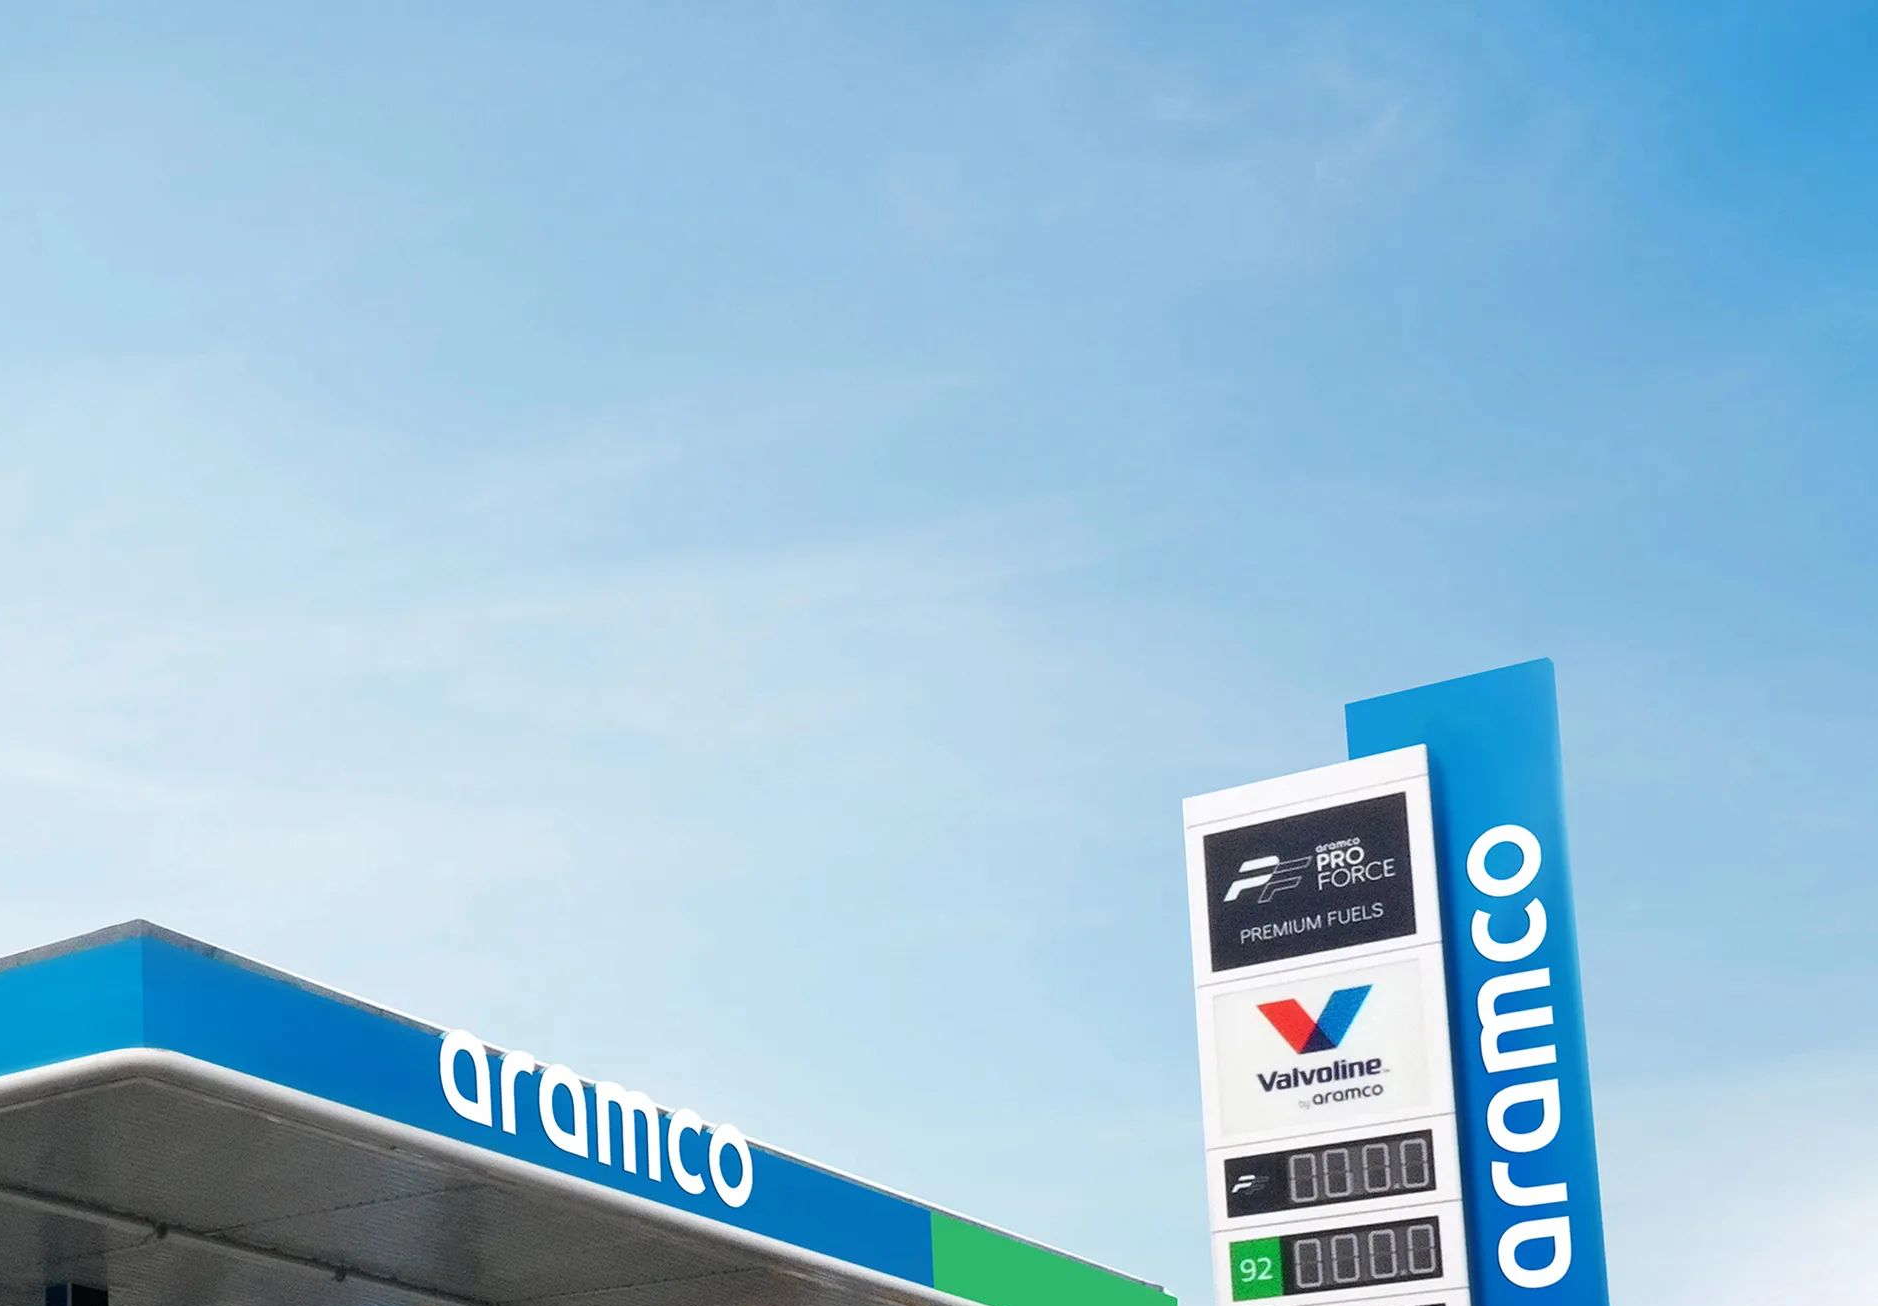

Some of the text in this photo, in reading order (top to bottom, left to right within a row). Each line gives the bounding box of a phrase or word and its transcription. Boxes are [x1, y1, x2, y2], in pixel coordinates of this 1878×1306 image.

[1315, 837, 1361, 853] aramco
[1316, 846, 1365, 871] PRO
[1317, 858, 1396, 890] FORCE
[1240, 902, 1384, 944] PREMIUM FUELS
[1466, 824, 1572, 1288] aramco
[1256, 1058, 1383, 1093] Valvoline
[1312, 1084, 1384, 1106] aramco
[439, 1028, 753, 1208] aramco
[1239, 1257, 1273, 1283] 92
